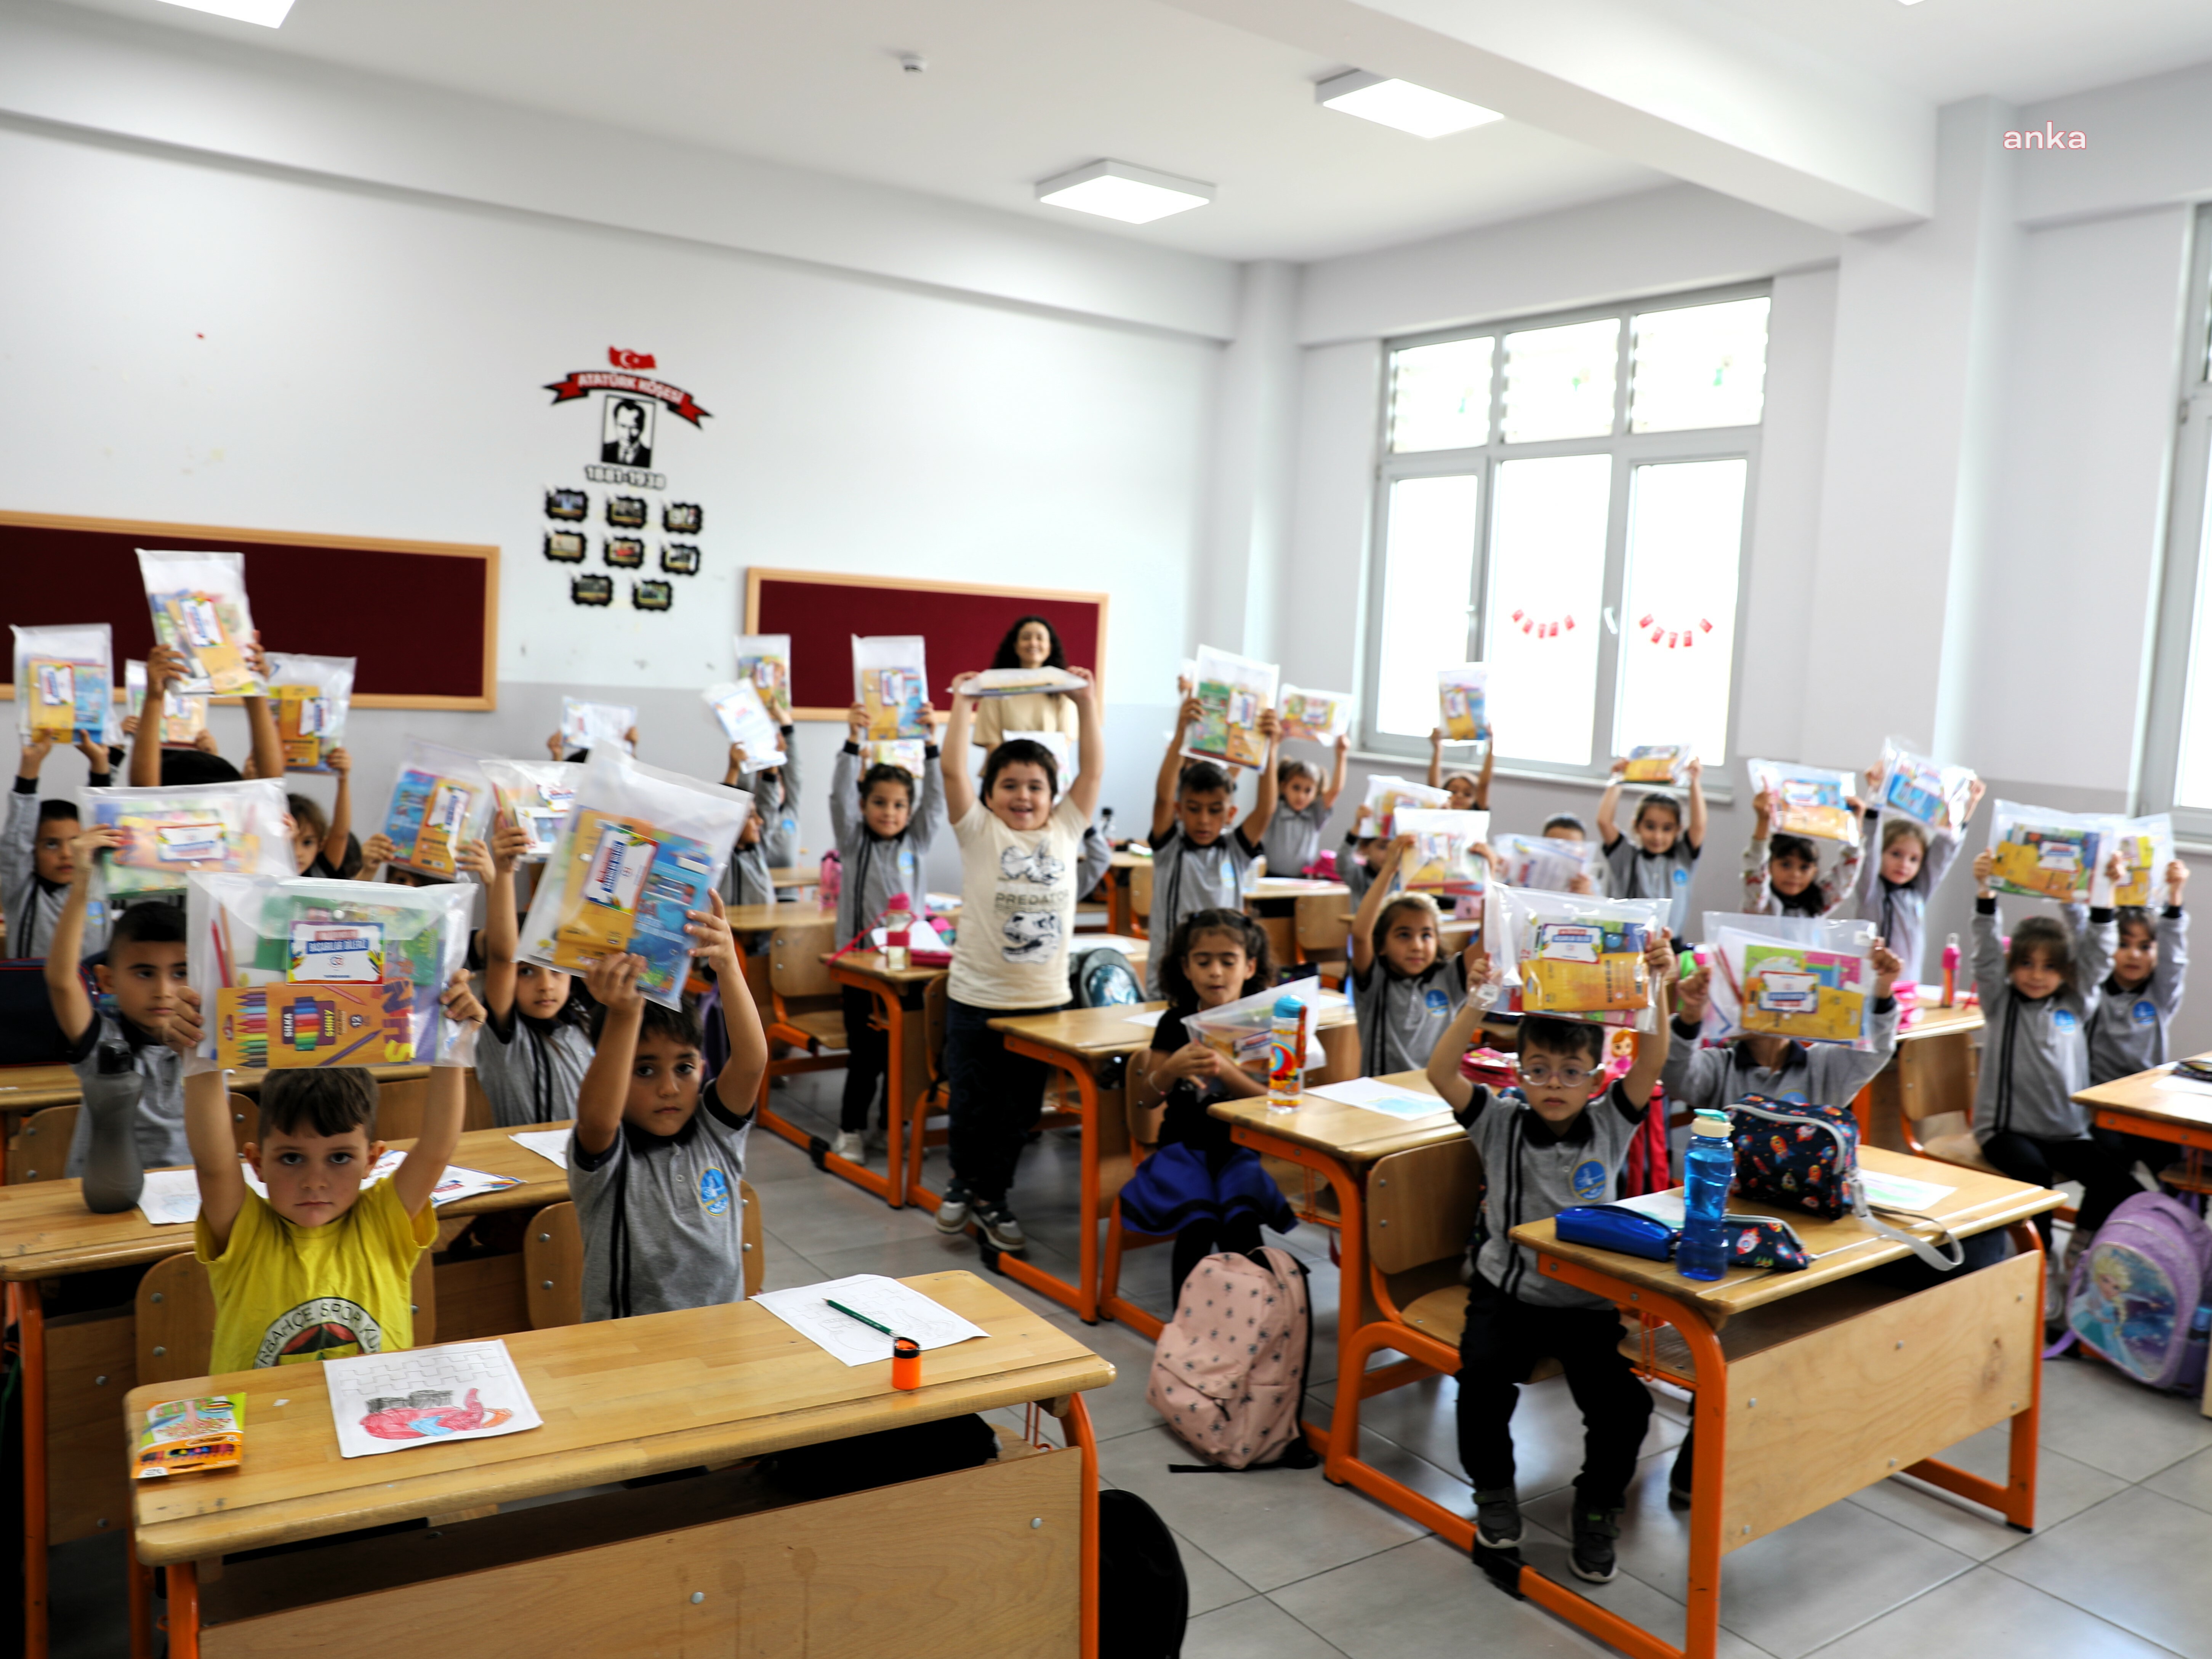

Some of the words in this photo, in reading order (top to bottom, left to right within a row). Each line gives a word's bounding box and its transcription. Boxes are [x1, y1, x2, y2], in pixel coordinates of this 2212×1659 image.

[578, 373, 636, 389] ATATÜRK
[585, 465, 666, 490] 1881-1938
[324, 1009, 335, 1037] SHINY
[320, 1303, 361, 1328] SPOR
